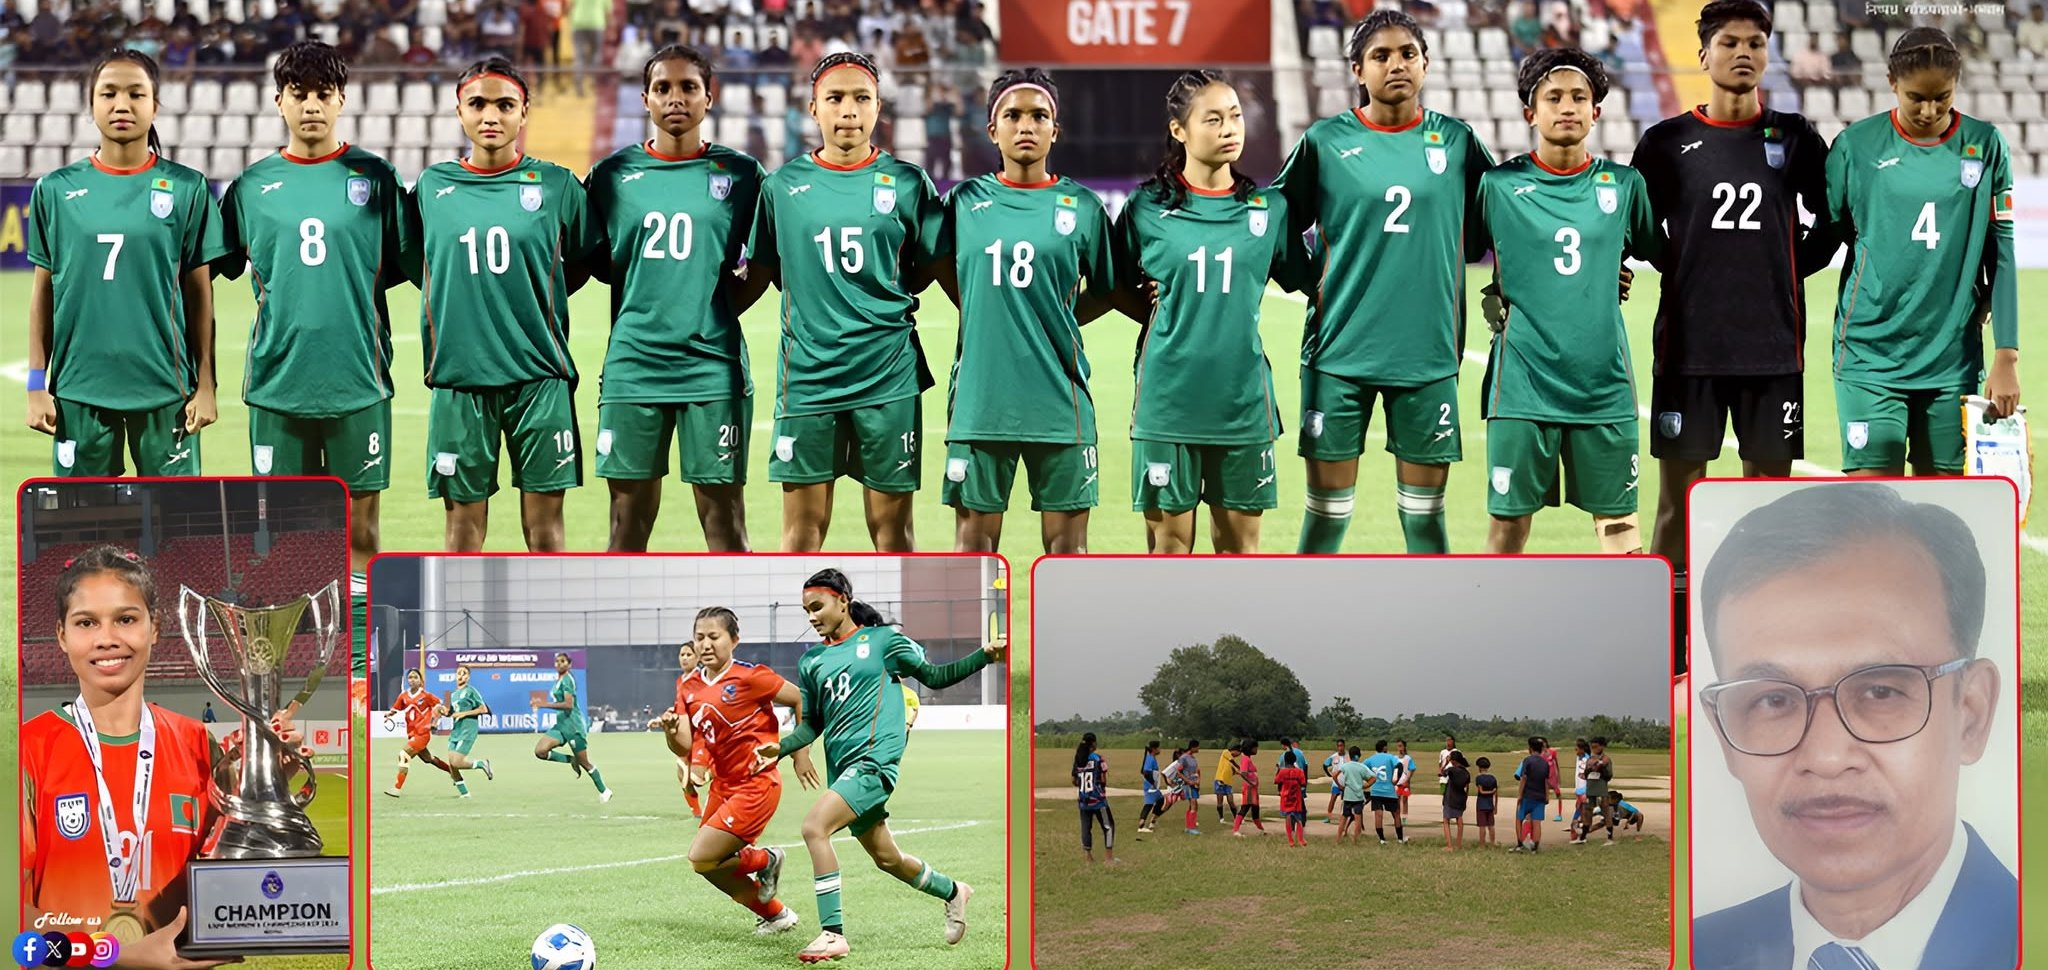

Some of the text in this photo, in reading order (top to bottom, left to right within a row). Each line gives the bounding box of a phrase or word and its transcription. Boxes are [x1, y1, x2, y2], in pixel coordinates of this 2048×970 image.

[1067, 0, 1190, 46] GATE 7
[1383, 184, 1412, 234] 2
[1711, 182, 1763, 230] 22
[1910, 201, 1941, 250] 4
[96, 233, 125, 281] 7
[299, 216, 327, 267] 8
[459, 225, 511, 275] 10
[642, 210, 693, 261] 20
[813, 225, 864, 274] 15
[1553, 225, 1582, 276] 3
[984, 238, 1035, 288] 18
[1187, 245, 1235, 294] 11
[718, 424, 739, 447] 20
[1438, 402, 1451, 426] 2
[368, 432, 380, 455] 8
[553, 429, 574, 454] 10
[1260, 448, 1274, 471] 11
[1631, 453, 1639, 477] 3
[1077, 771, 1094, 793] 18
[214, 903, 332, 922] CHAMPION
